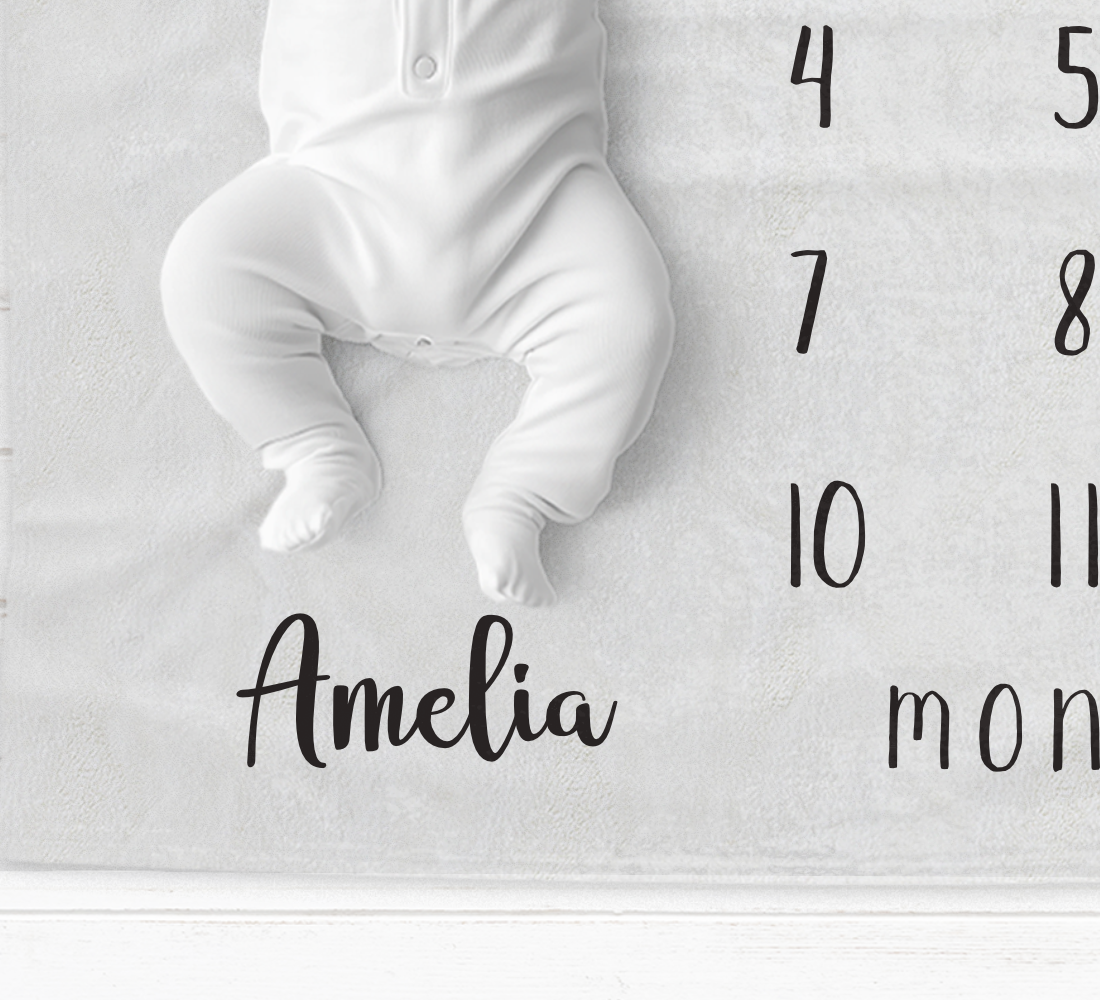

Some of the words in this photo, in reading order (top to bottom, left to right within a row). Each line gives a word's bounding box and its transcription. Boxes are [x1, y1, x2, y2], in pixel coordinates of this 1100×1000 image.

[790, 23, 835, 130] 4
[1053, 24, 1100, 131] 5
[789, 248, 829, 356] 7
[1053, 248, 1097, 357] 8
[789, 479, 867, 590] 10
[1049, 481, 1100, 589] 11
[235, 612, 619, 770] Amelia
